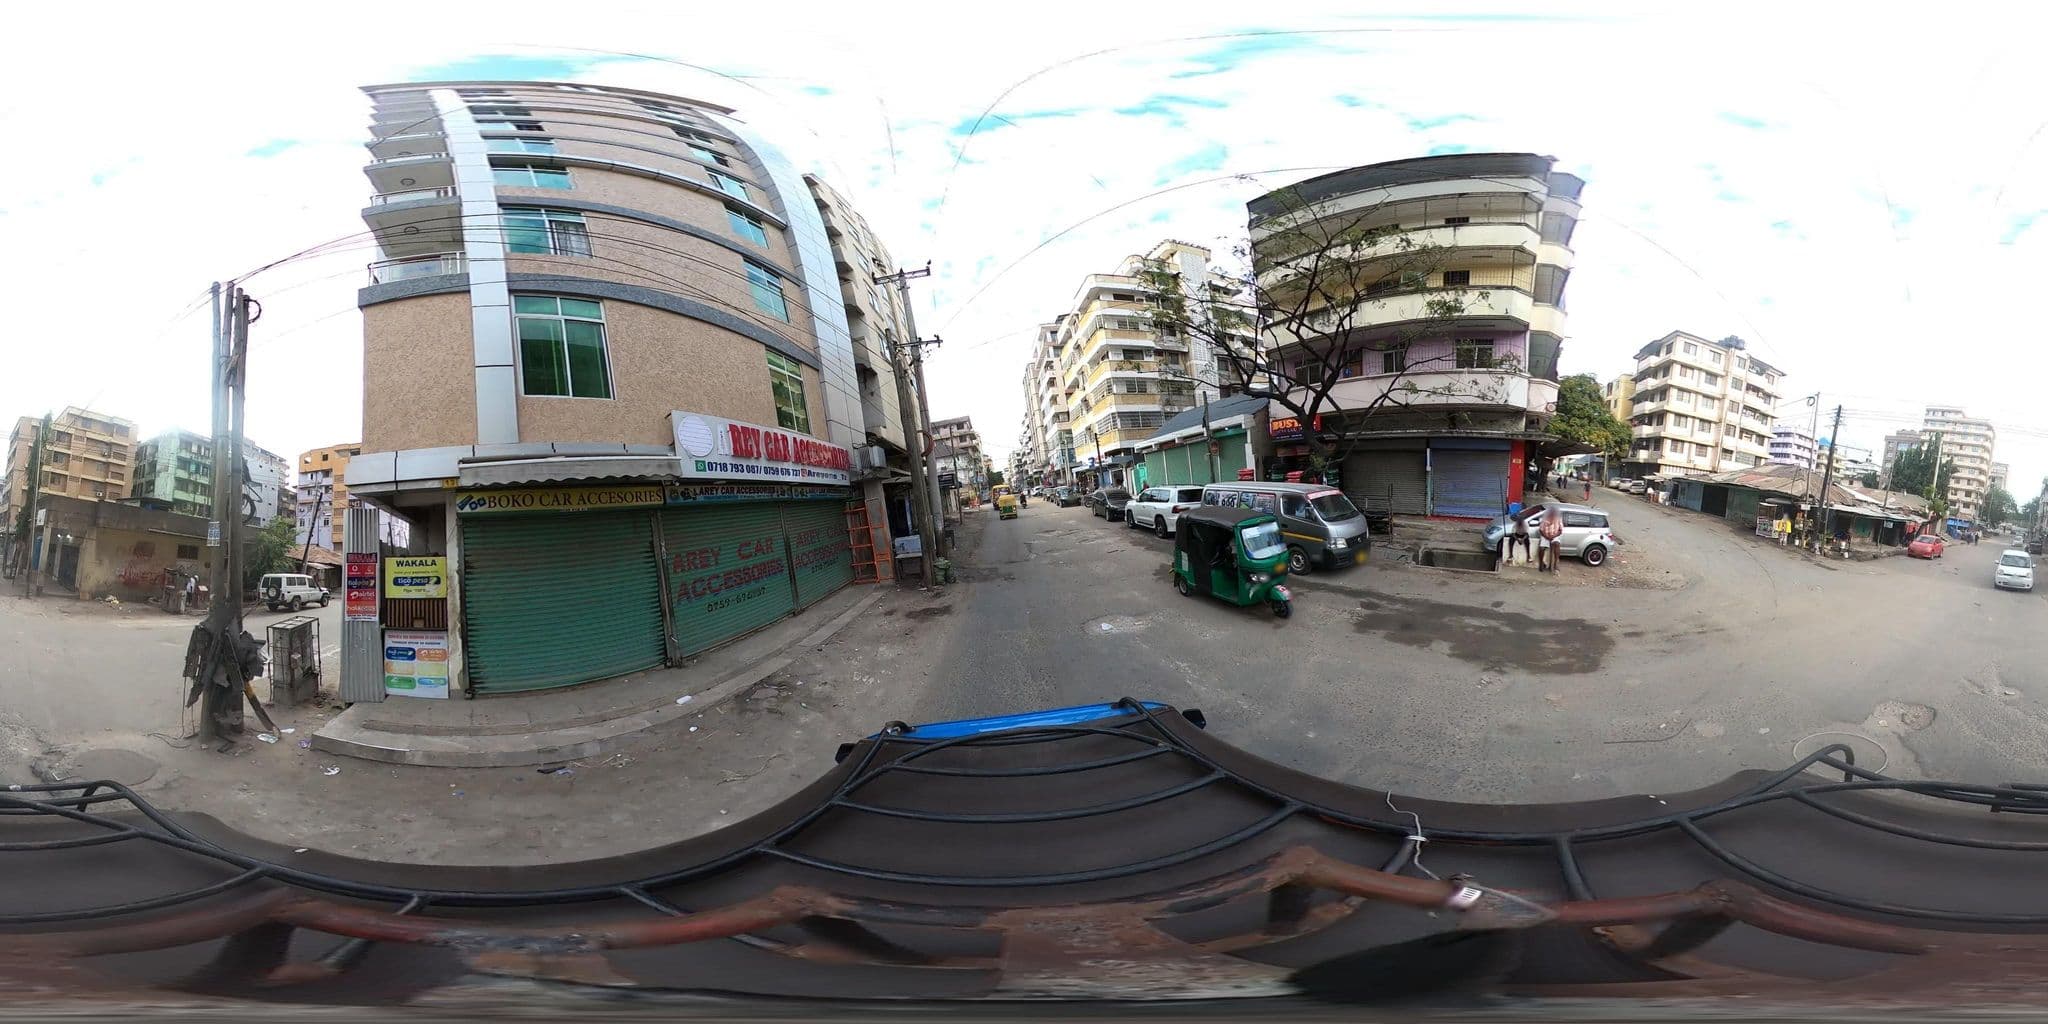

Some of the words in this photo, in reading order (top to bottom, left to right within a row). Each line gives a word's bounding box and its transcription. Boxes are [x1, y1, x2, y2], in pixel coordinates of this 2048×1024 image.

[764, 430, 791, 463] CAR
[708, 461, 728, 472] 0718
[729, 462, 745, 474] 793
[764, 466, 779, 476] 0759
[487, 493, 536, 509] BOKO
[539, 491, 573, 507] CAR
[577, 488, 663, 506] ACCESORIES
[720, 486, 735, 496] CAR
[395, 559, 437, 568] WAKALA
[673, 546, 721, 574] AREY
[736, 536, 774, 561] CAR
[677, 558, 785, 602] ACCESSORIES
